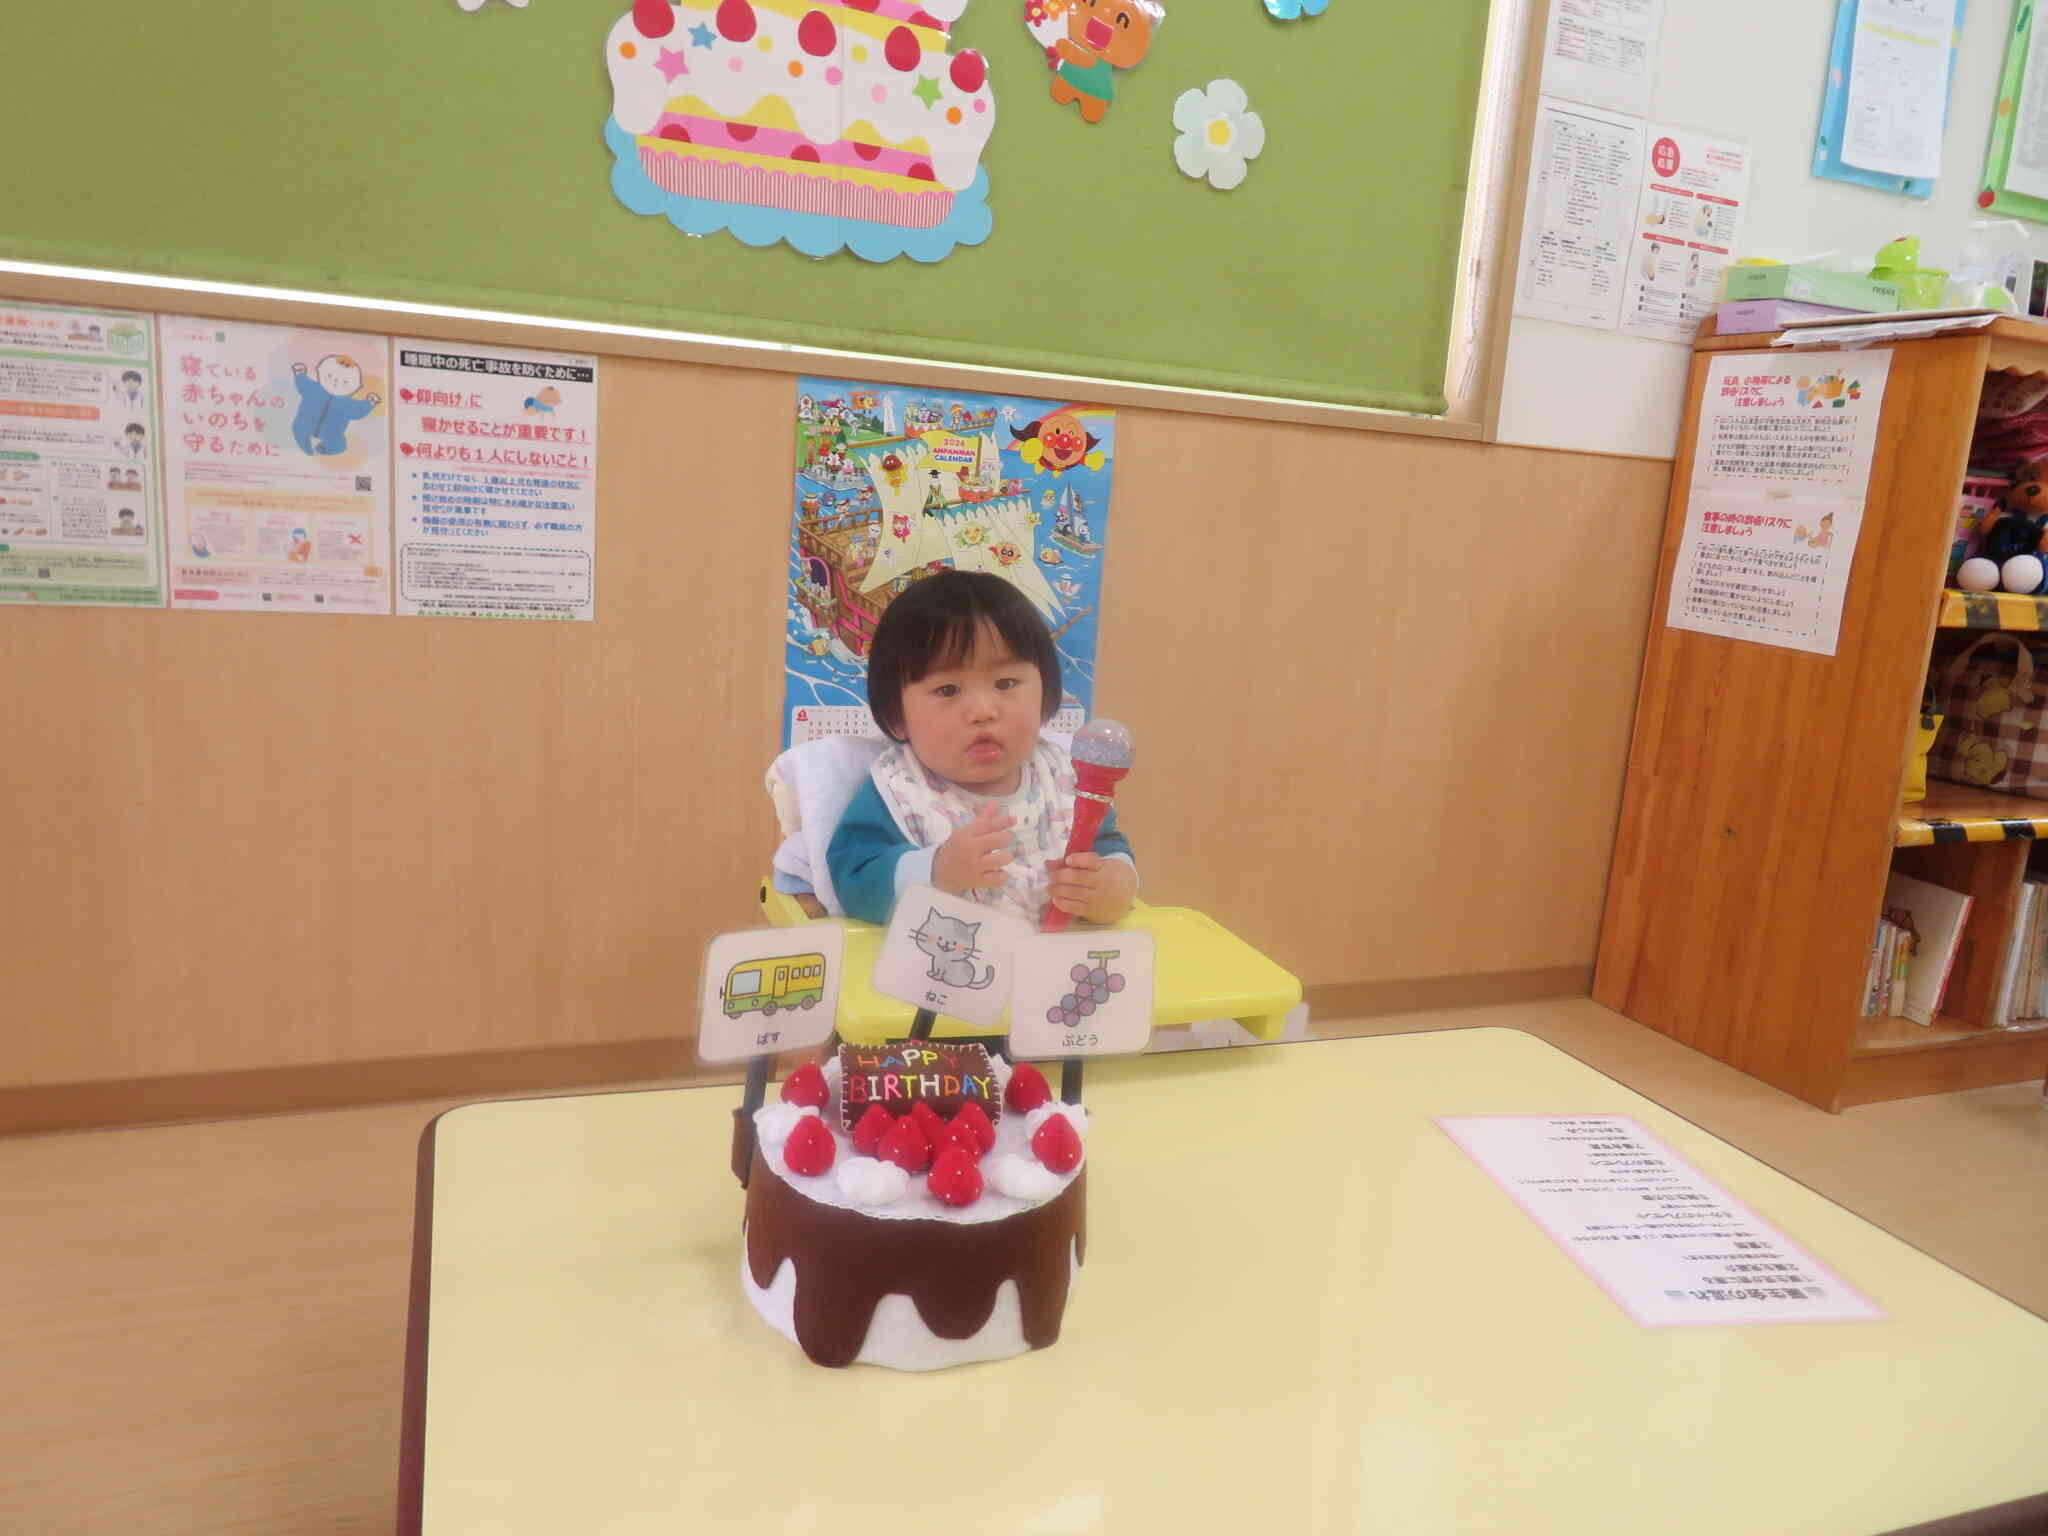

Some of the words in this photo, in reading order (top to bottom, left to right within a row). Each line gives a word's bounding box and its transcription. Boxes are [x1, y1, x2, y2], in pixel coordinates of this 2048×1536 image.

[181, 354, 257, 381] 寝ている
[182, 383, 286, 408] 赤ちゃんの
[1734, 397, 1785, 408] 注意しましょう
[182, 411, 267, 432] いのちを
[183, 433, 280, 456] 守るために
[1702, 522, 1753, 536] 注意しましょう
[924, 990, 949, 1005] ねこ
[756, 1031, 781, 1046] ばす
[1061, 1033, 1099, 1047] ぶどう
[857, 1049, 960, 1067] HAPPY
[851, 1074, 992, 1102] BIRTHDAY
